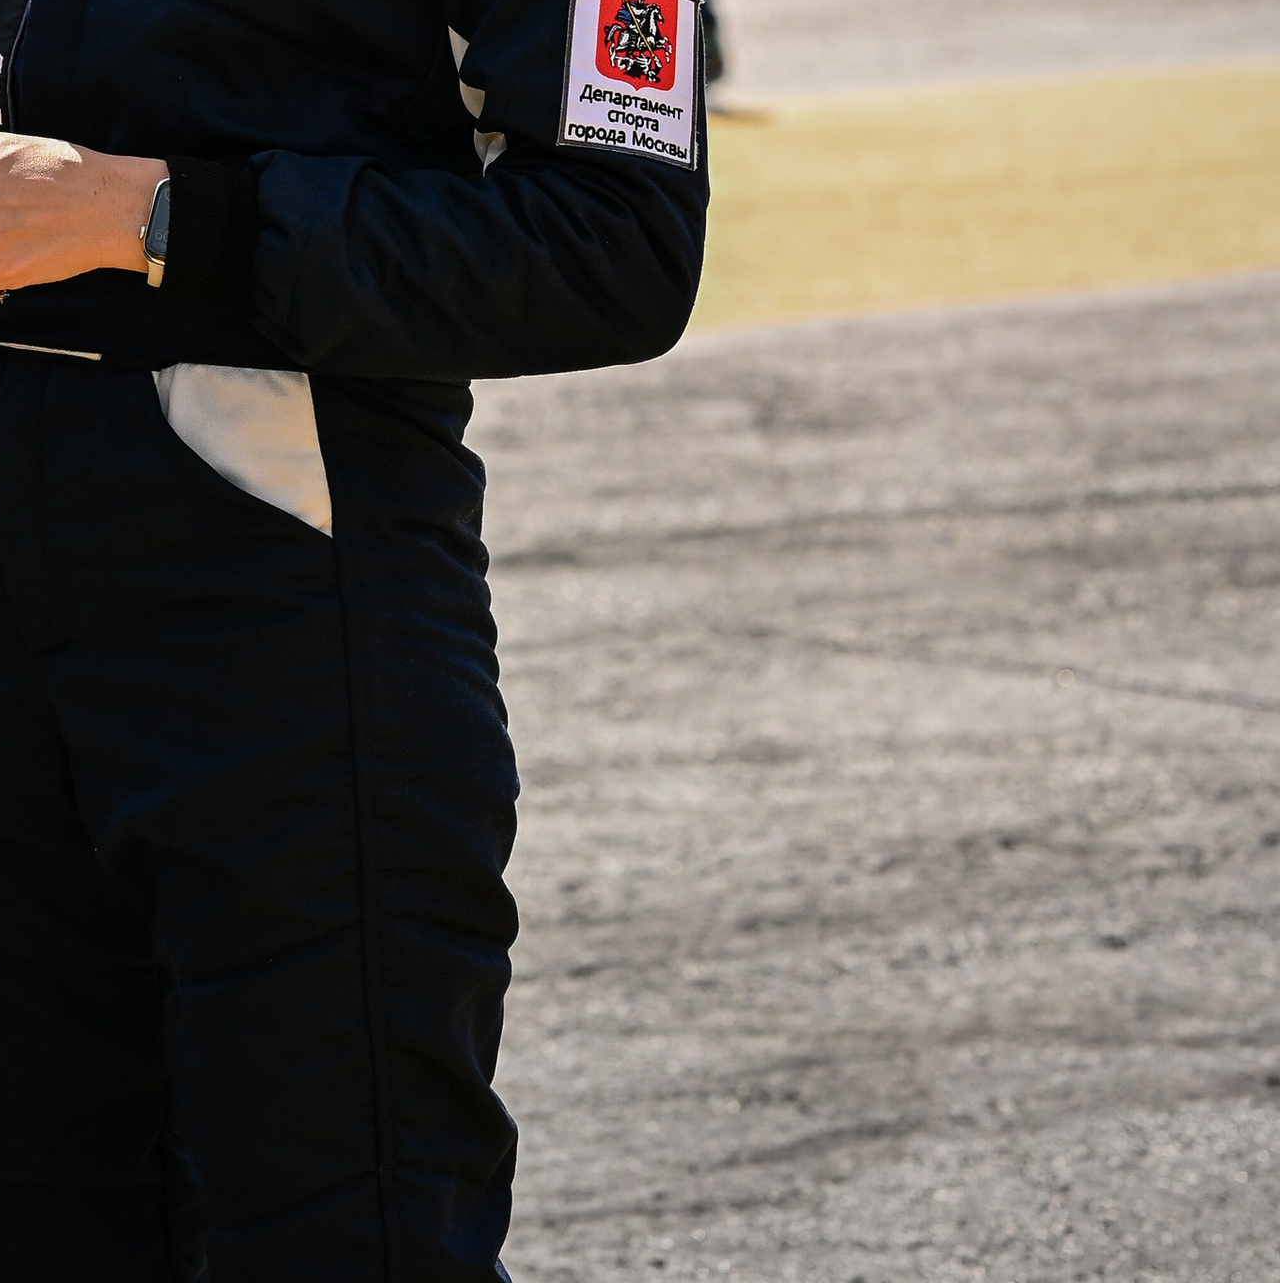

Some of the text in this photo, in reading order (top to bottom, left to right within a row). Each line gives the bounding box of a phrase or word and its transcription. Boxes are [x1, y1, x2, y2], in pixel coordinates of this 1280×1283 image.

[579, 84, 684, 121] Департамент
[607, 110, 660, 132] спорта
[568, 123, 688, 160] города Москвы
